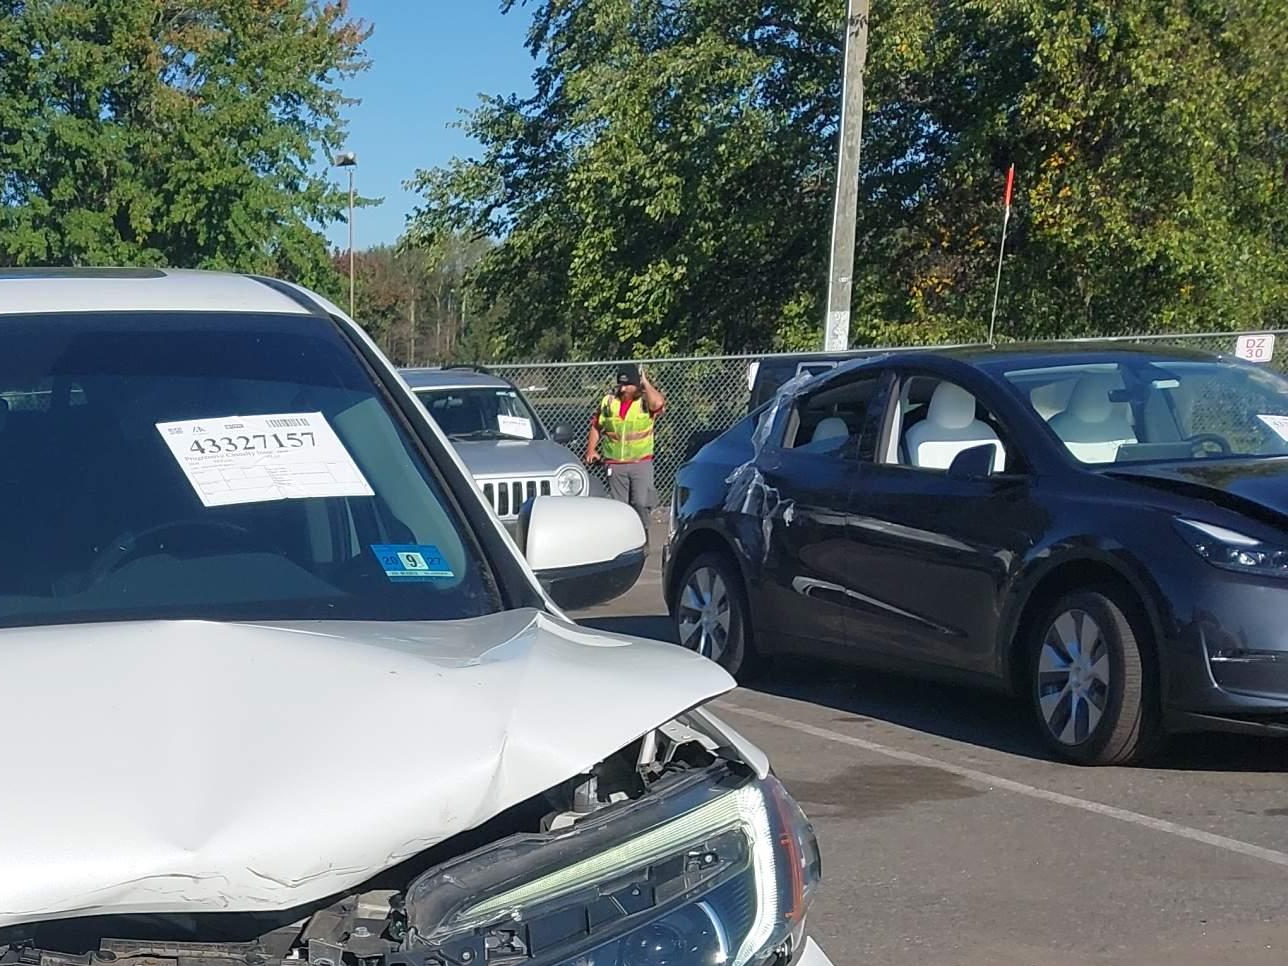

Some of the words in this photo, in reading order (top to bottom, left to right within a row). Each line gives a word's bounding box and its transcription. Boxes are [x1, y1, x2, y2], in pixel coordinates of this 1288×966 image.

[1246, 338, 1265, 348] DZ
[1245, 348, 1263, 358] 30
[190, 431, 316, 454] 43327157
[405, 554, 418, 568] 9
